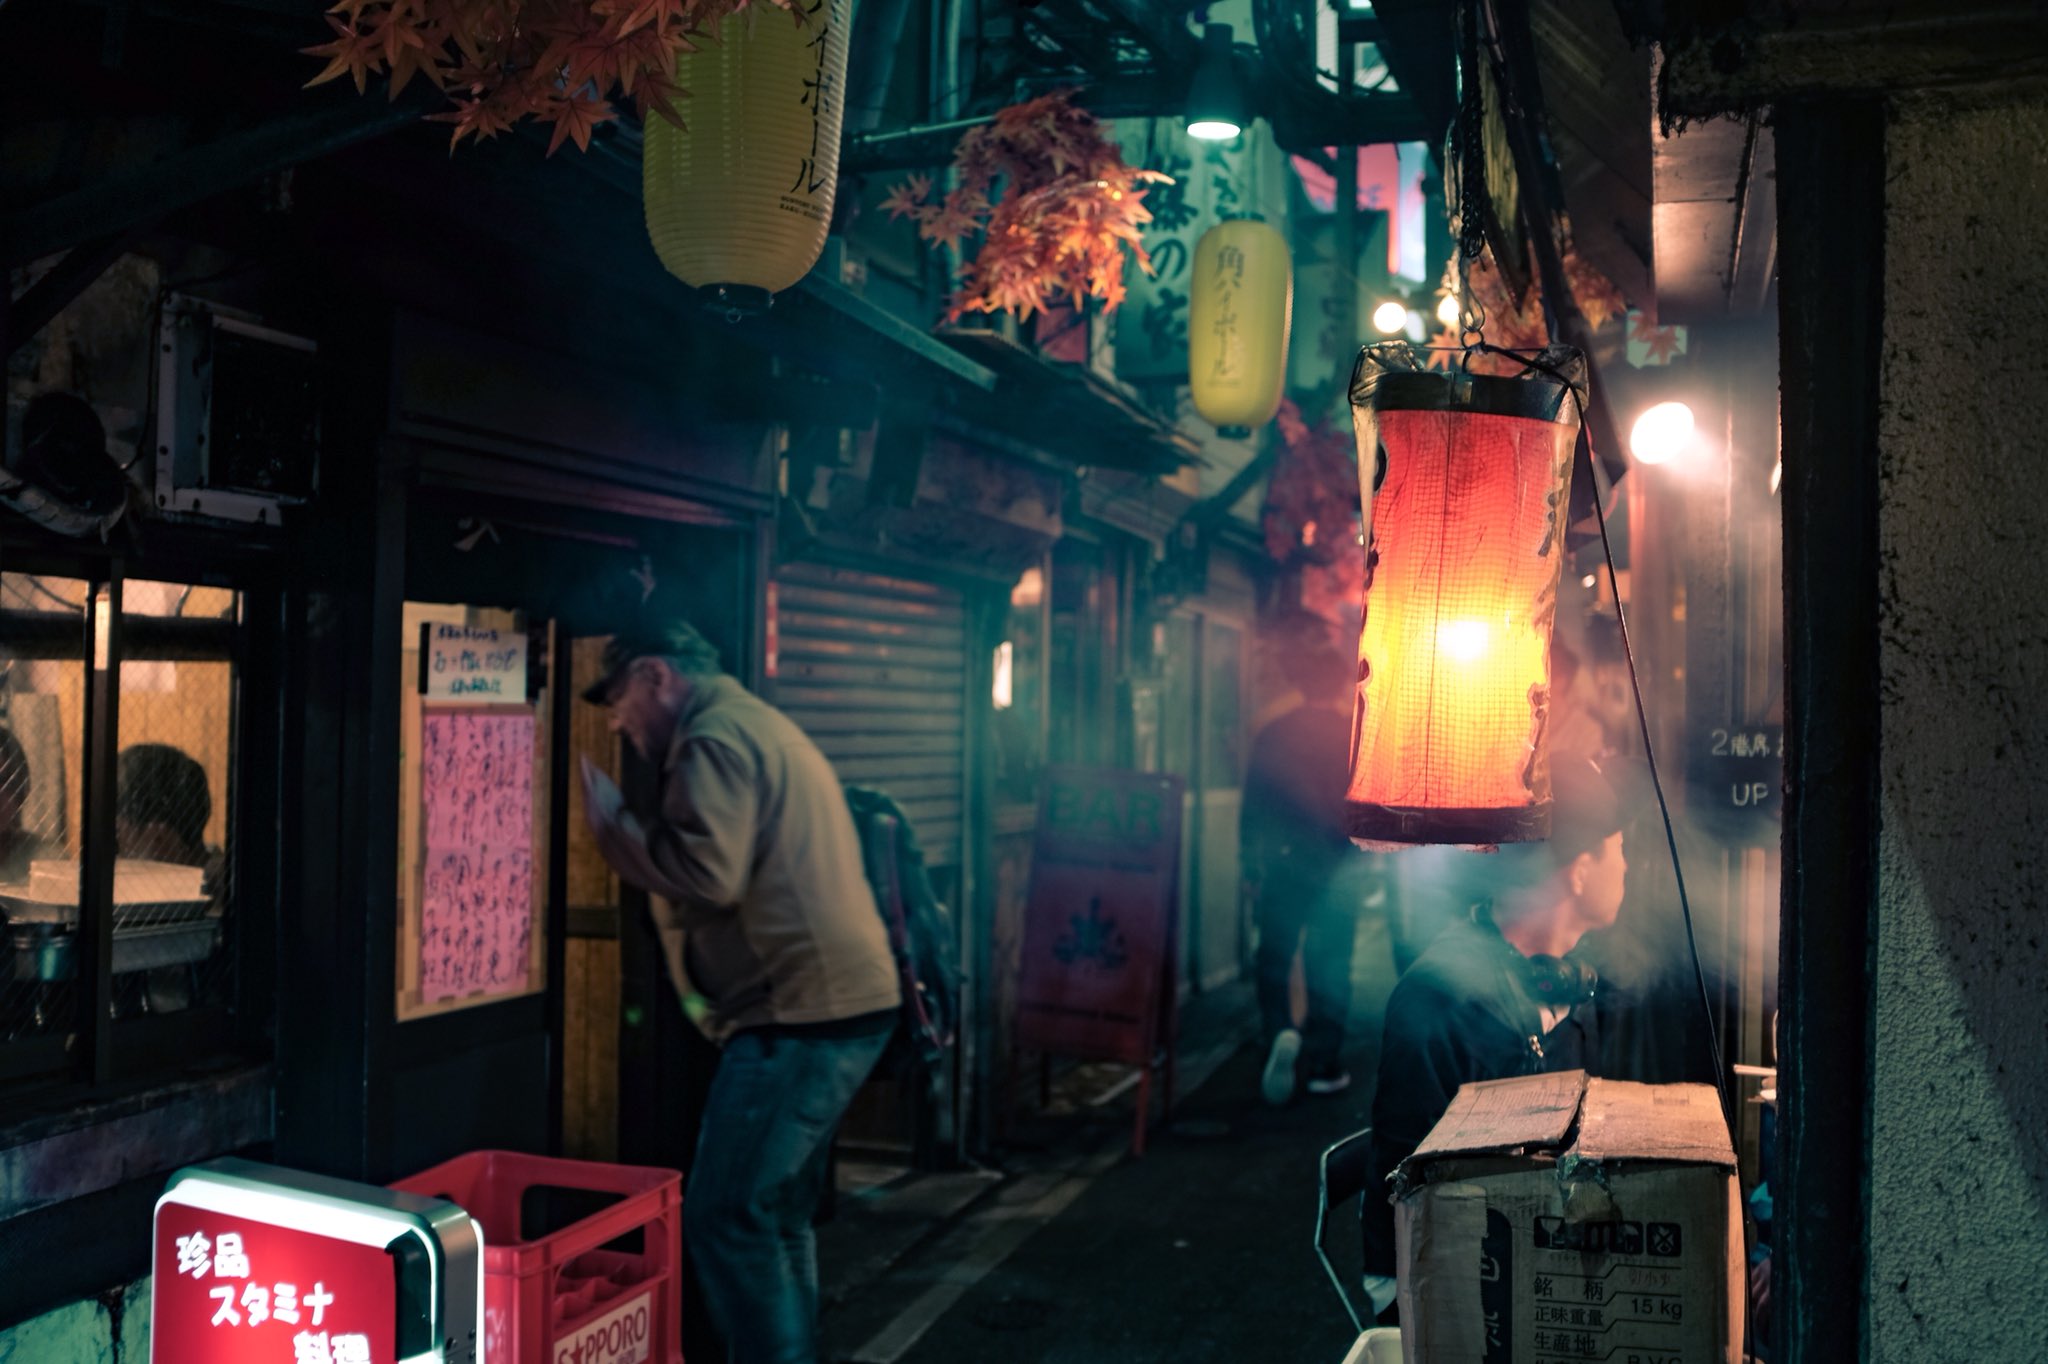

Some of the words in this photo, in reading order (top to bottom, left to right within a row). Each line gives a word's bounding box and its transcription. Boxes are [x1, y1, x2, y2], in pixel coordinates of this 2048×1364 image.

[1732, 782, 1769, 806] UP
[1047, 784, 1163, 842] BAR
[175, 1230, 250, 1280] 珍品
[208, 1280, 336, 1328] スタミナ
[1535, 1305, 1604, 1328] 正味重量
[1631, 1298, 1654, 1315] 15
[1660, 1299, 1683, 1321] kg
[1534, 1331, 1597, 1356] 生産地
